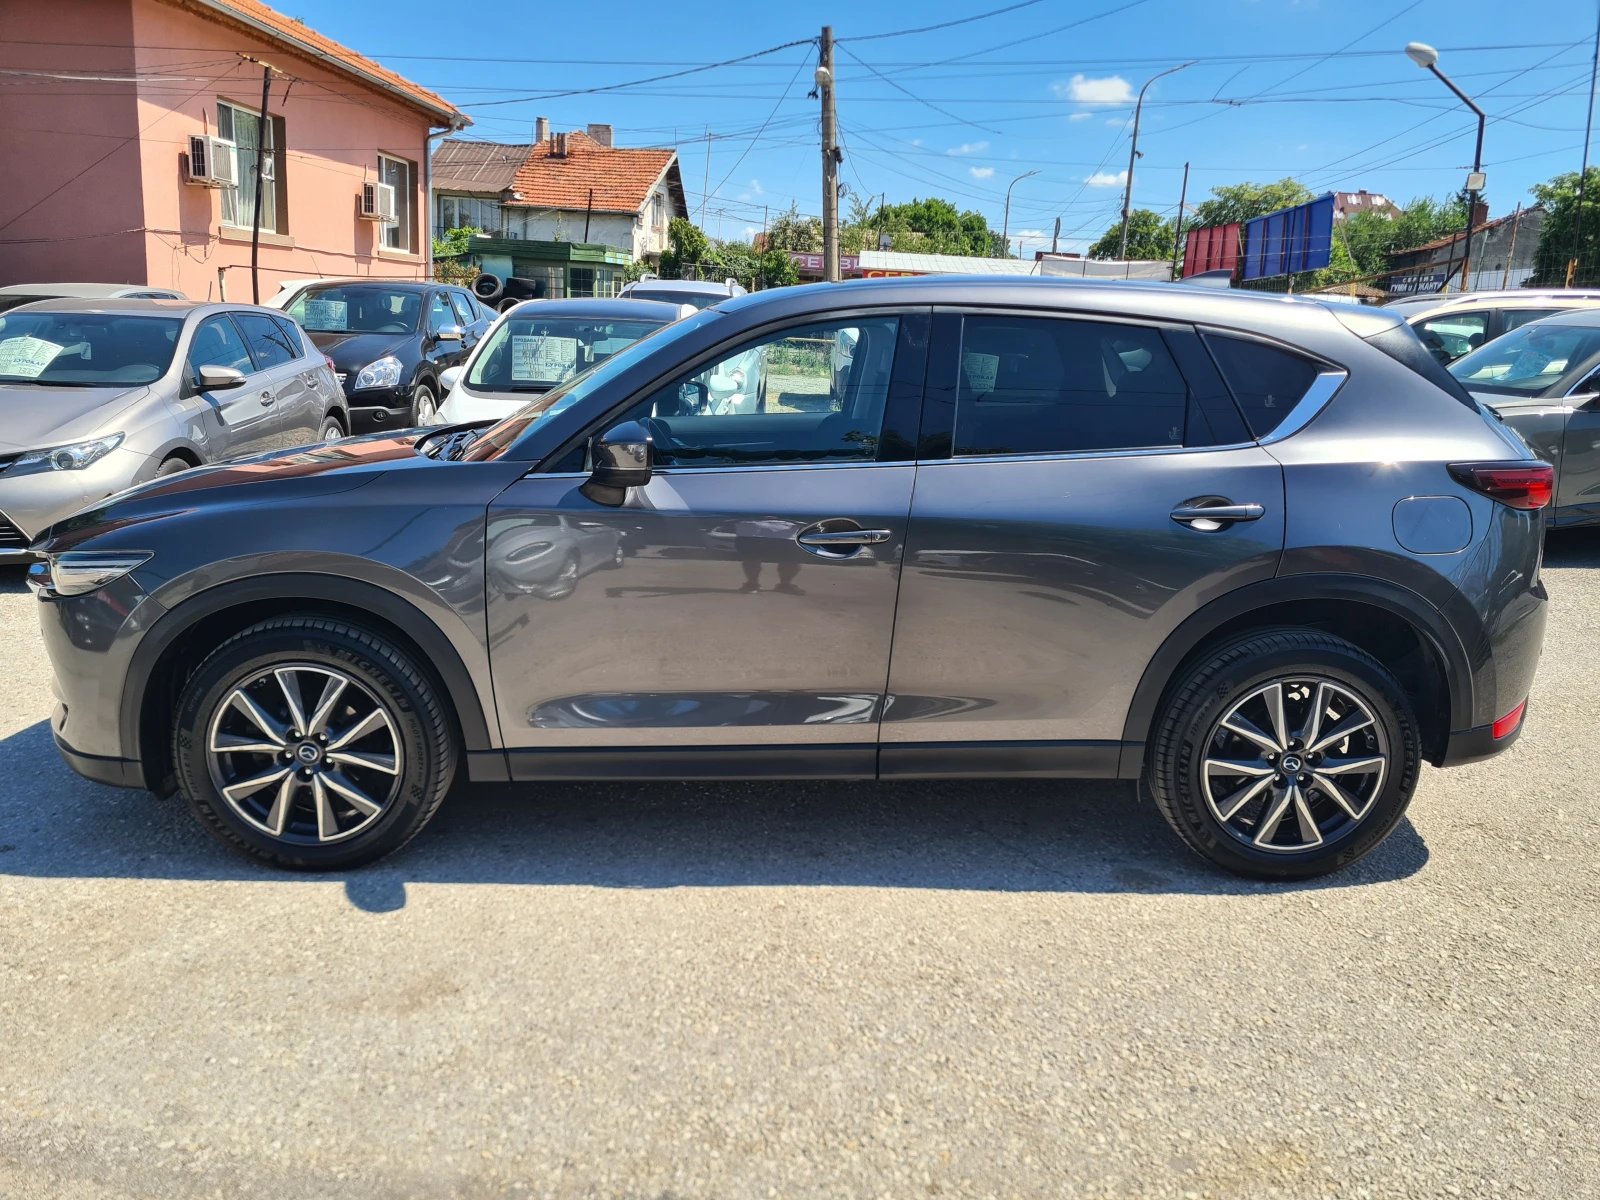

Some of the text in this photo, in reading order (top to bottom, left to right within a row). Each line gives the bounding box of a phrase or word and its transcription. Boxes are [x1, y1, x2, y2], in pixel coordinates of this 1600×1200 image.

[335, 649, 410, 710] MICHELIN
[408, 718, 421, 739] PILOT
[1394, 709, 1414, 788] MICHELIN
[1179, 745, 1201, 824] MICHELIN
